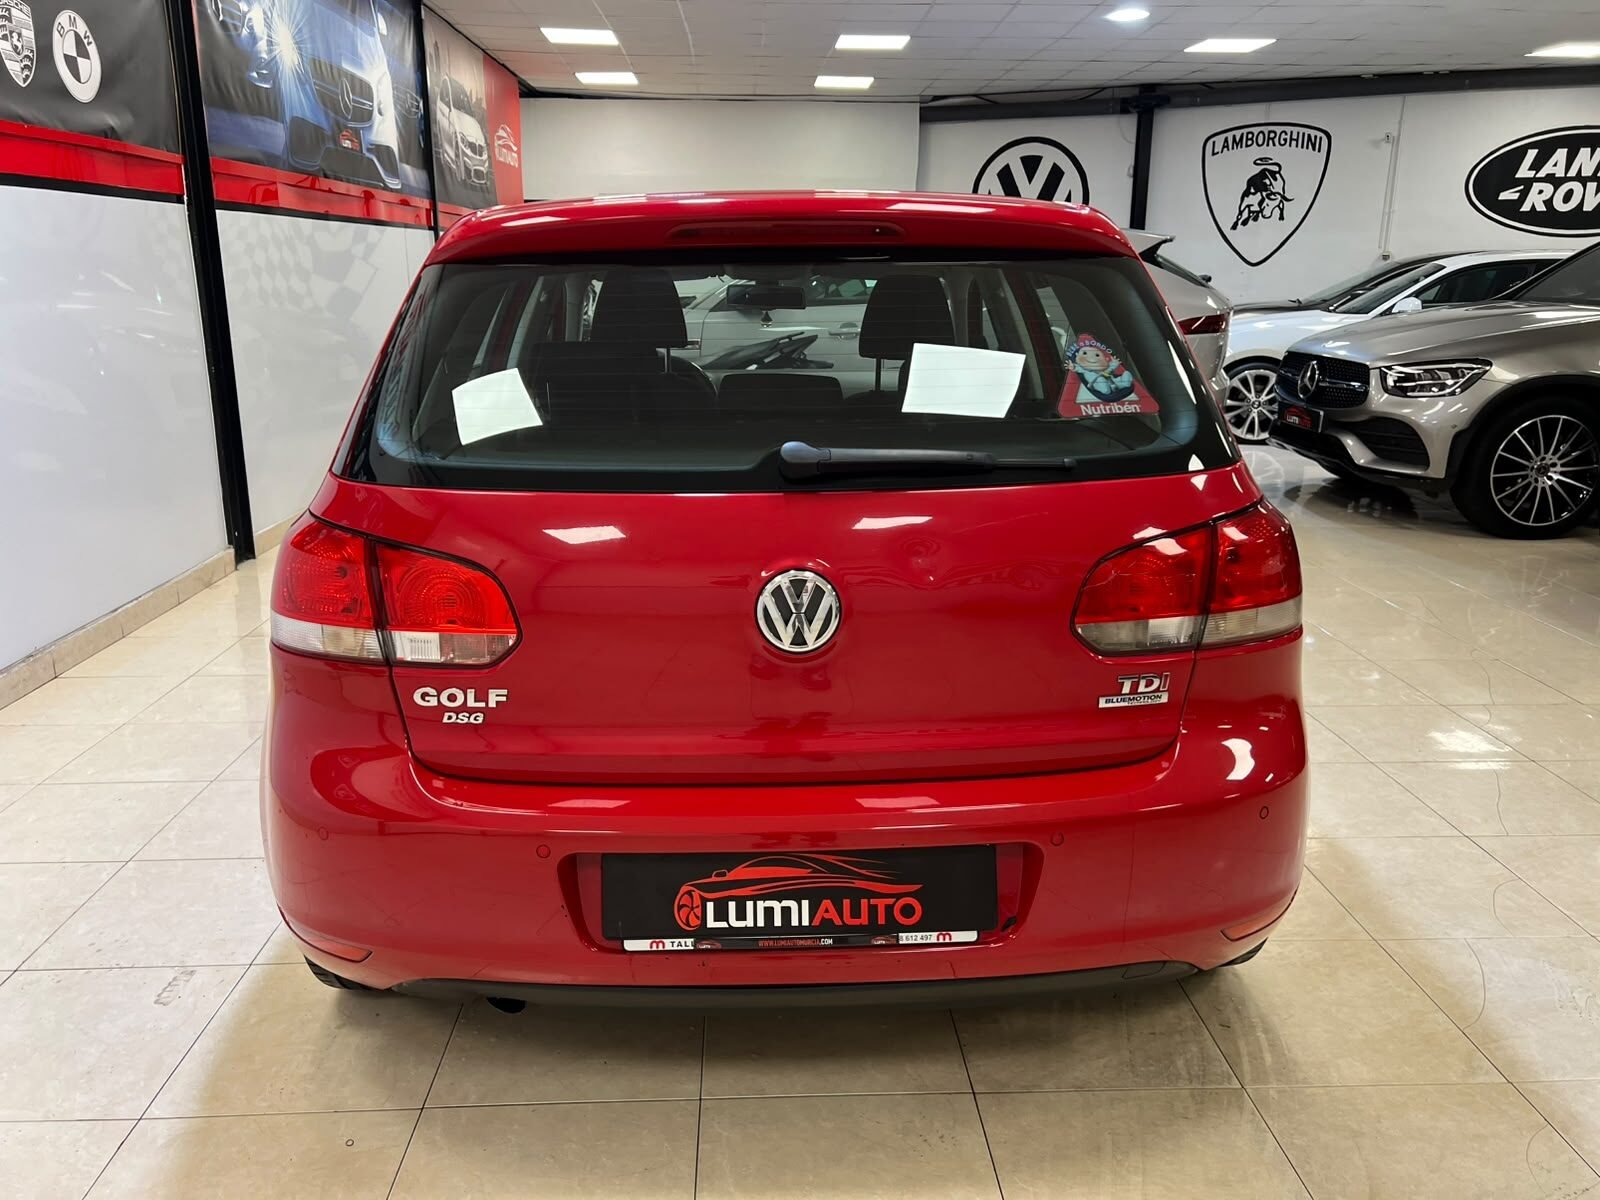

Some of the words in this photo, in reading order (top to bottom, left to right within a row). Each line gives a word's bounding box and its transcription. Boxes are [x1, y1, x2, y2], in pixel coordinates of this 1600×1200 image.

[56, 14, 93, 47] BMW
[1211, 130, 1323, 157] LAMBORGHINI
[1514, 147, 1600, 178] LAN
[1080, 402, 1141, 416] Nutribén
[1117, 672, 1171, 694] TDI
[413, 686, 508, 708] GOLF
[1105, 694, 1163, 704] BLUEMOTION
[442, 711, 485, 724] DSG
[706, 897, 923, 929] LUMIAUTO
